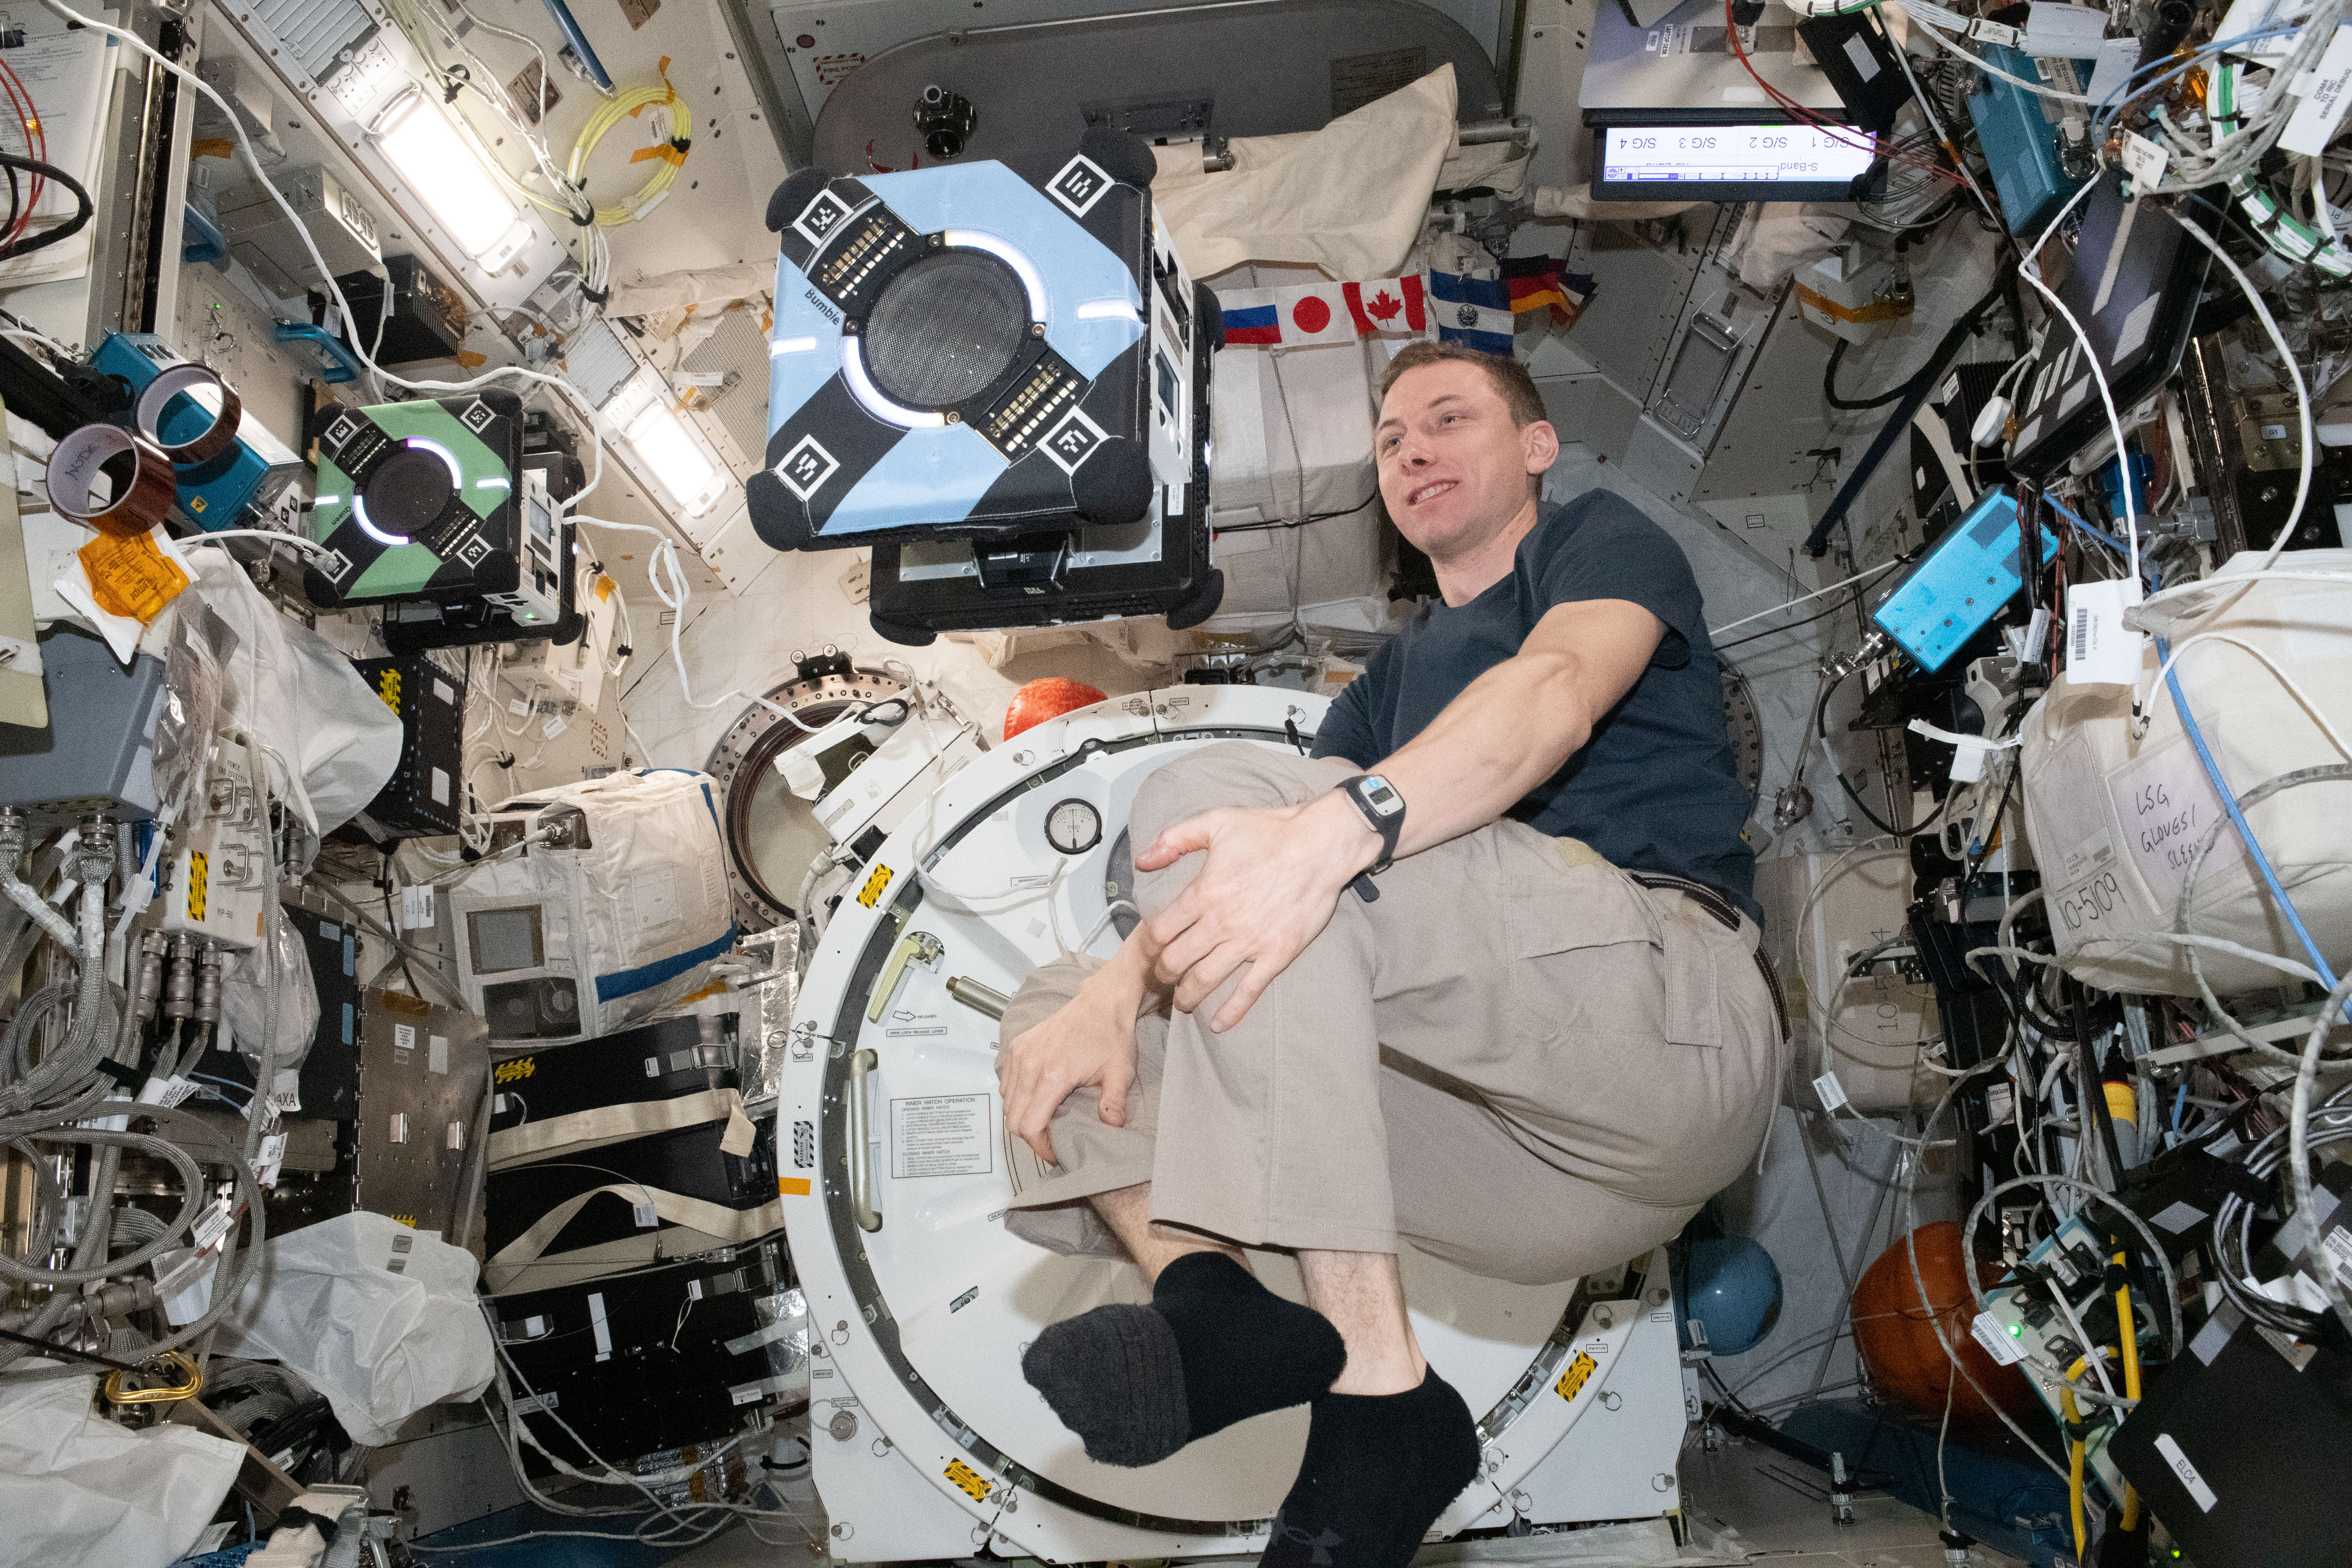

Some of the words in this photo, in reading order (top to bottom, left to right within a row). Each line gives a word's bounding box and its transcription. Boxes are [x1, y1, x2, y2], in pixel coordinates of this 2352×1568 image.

[2314, 78, 2329, 100] COM4
[2320, 94, 2338, 119] SERIAL
[2334, 68, 2352, 94] DEBUG
[2321, 94, 2328, 103] TO
[2327, 79, 2337, 93] RIC
[1620, 139, 1627, 148] 4
[1632, 138, 1657, 149] S/G
[1679, 138, 1686, 148] 3
[1692, 138, 1717, 149] S/G
[1750, 138, 1757, 148] 2
[1763, 137, 1788, 148] S/G
[1812, 137, 1817, 148] 1
[1824, 137, 1849, 148] S/G
[1780, 160, 1818, 172] S-Band
[2330, 211, 2341, 220] P1
[804, 288, 842, 326] Bumble
[65, 444, 97, 481] NODE
[331, 506, 351, 525] Queen
[226, 760, 241, 770] POWER
[217, 766, 227, 774] END
[226, 770, 249, 784] EFFECTOR
[2136, 784, 2170, 815] LSG
[195, 871, 204, 902] WARNING
[862, 882, 875, 899] CAUTION
[275, 1092, 296, 1106] AXA
[2054, 1318, 2063, 1327] OFF
[2038, 1331, 2045, 1339] ON
[1561, 1372, 1576, 1390] CAUTION
[954, 1465, 972, 1480] CAUTION
[2175, 1459, 2197, 1484] ELC4
